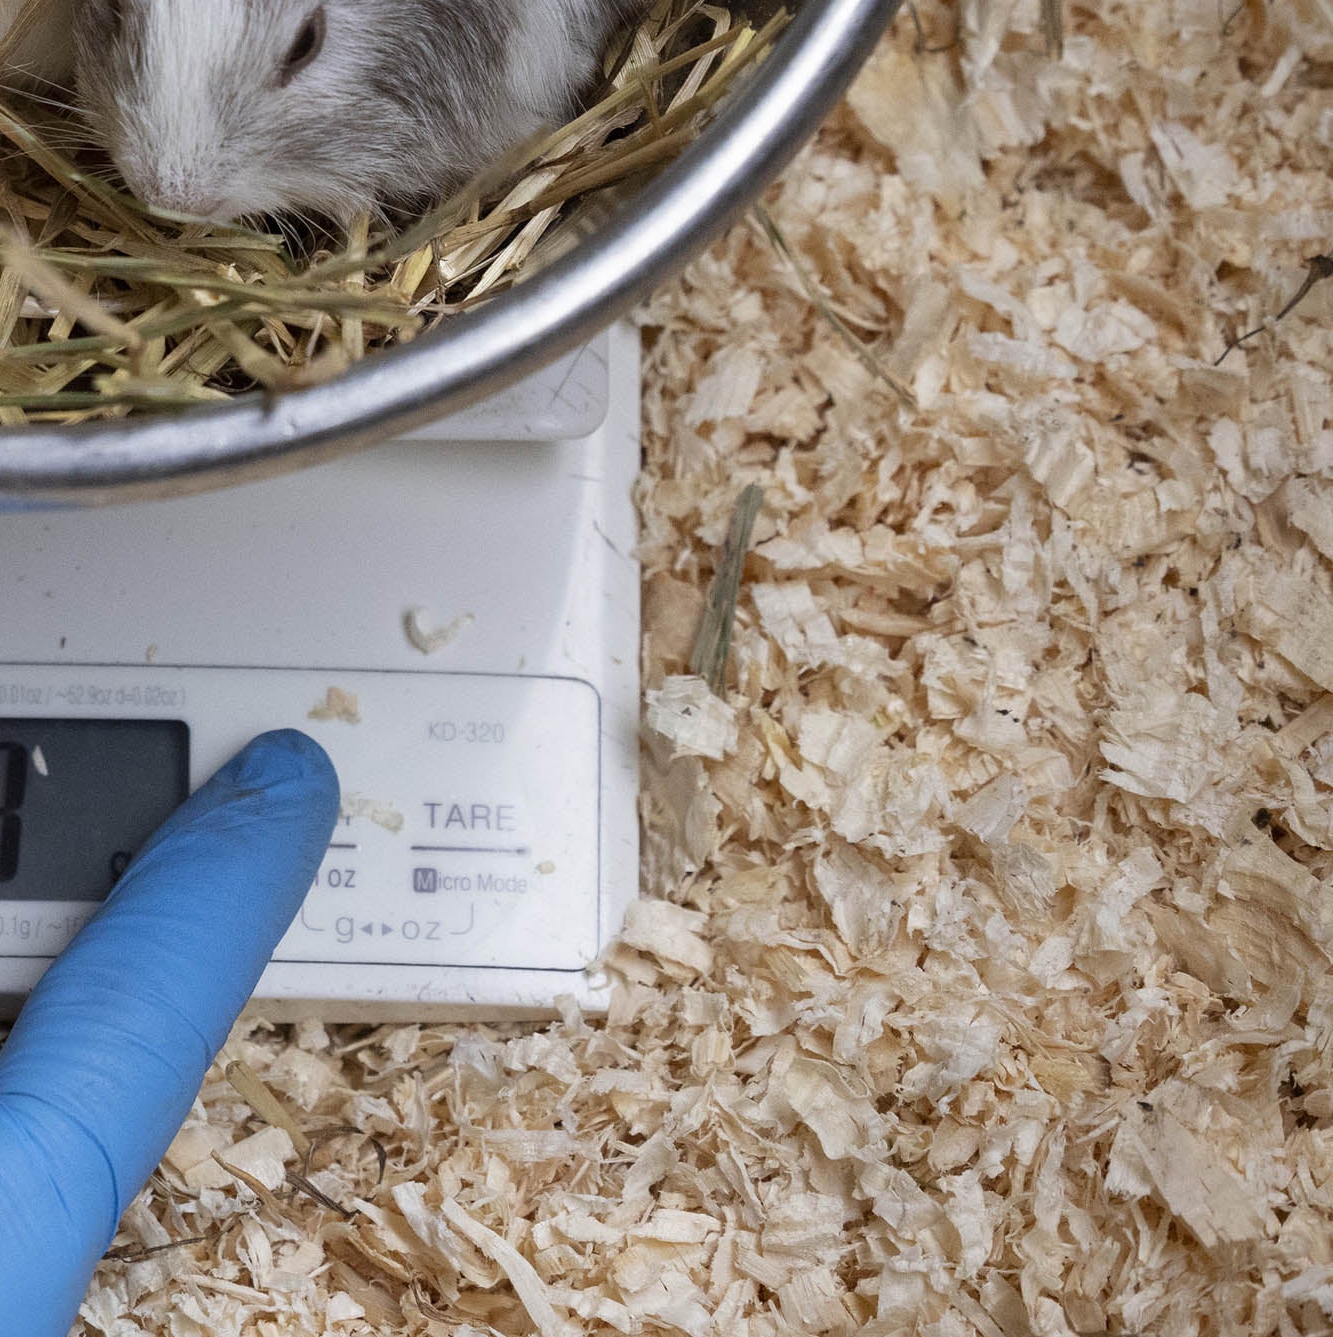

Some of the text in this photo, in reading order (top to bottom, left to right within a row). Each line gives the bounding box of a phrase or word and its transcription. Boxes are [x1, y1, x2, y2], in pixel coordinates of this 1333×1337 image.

[428, 721, 506, 744] KD-320
[423, 801, 517, 831] TARE
[413, 868, 528, 894] Micro Mode
